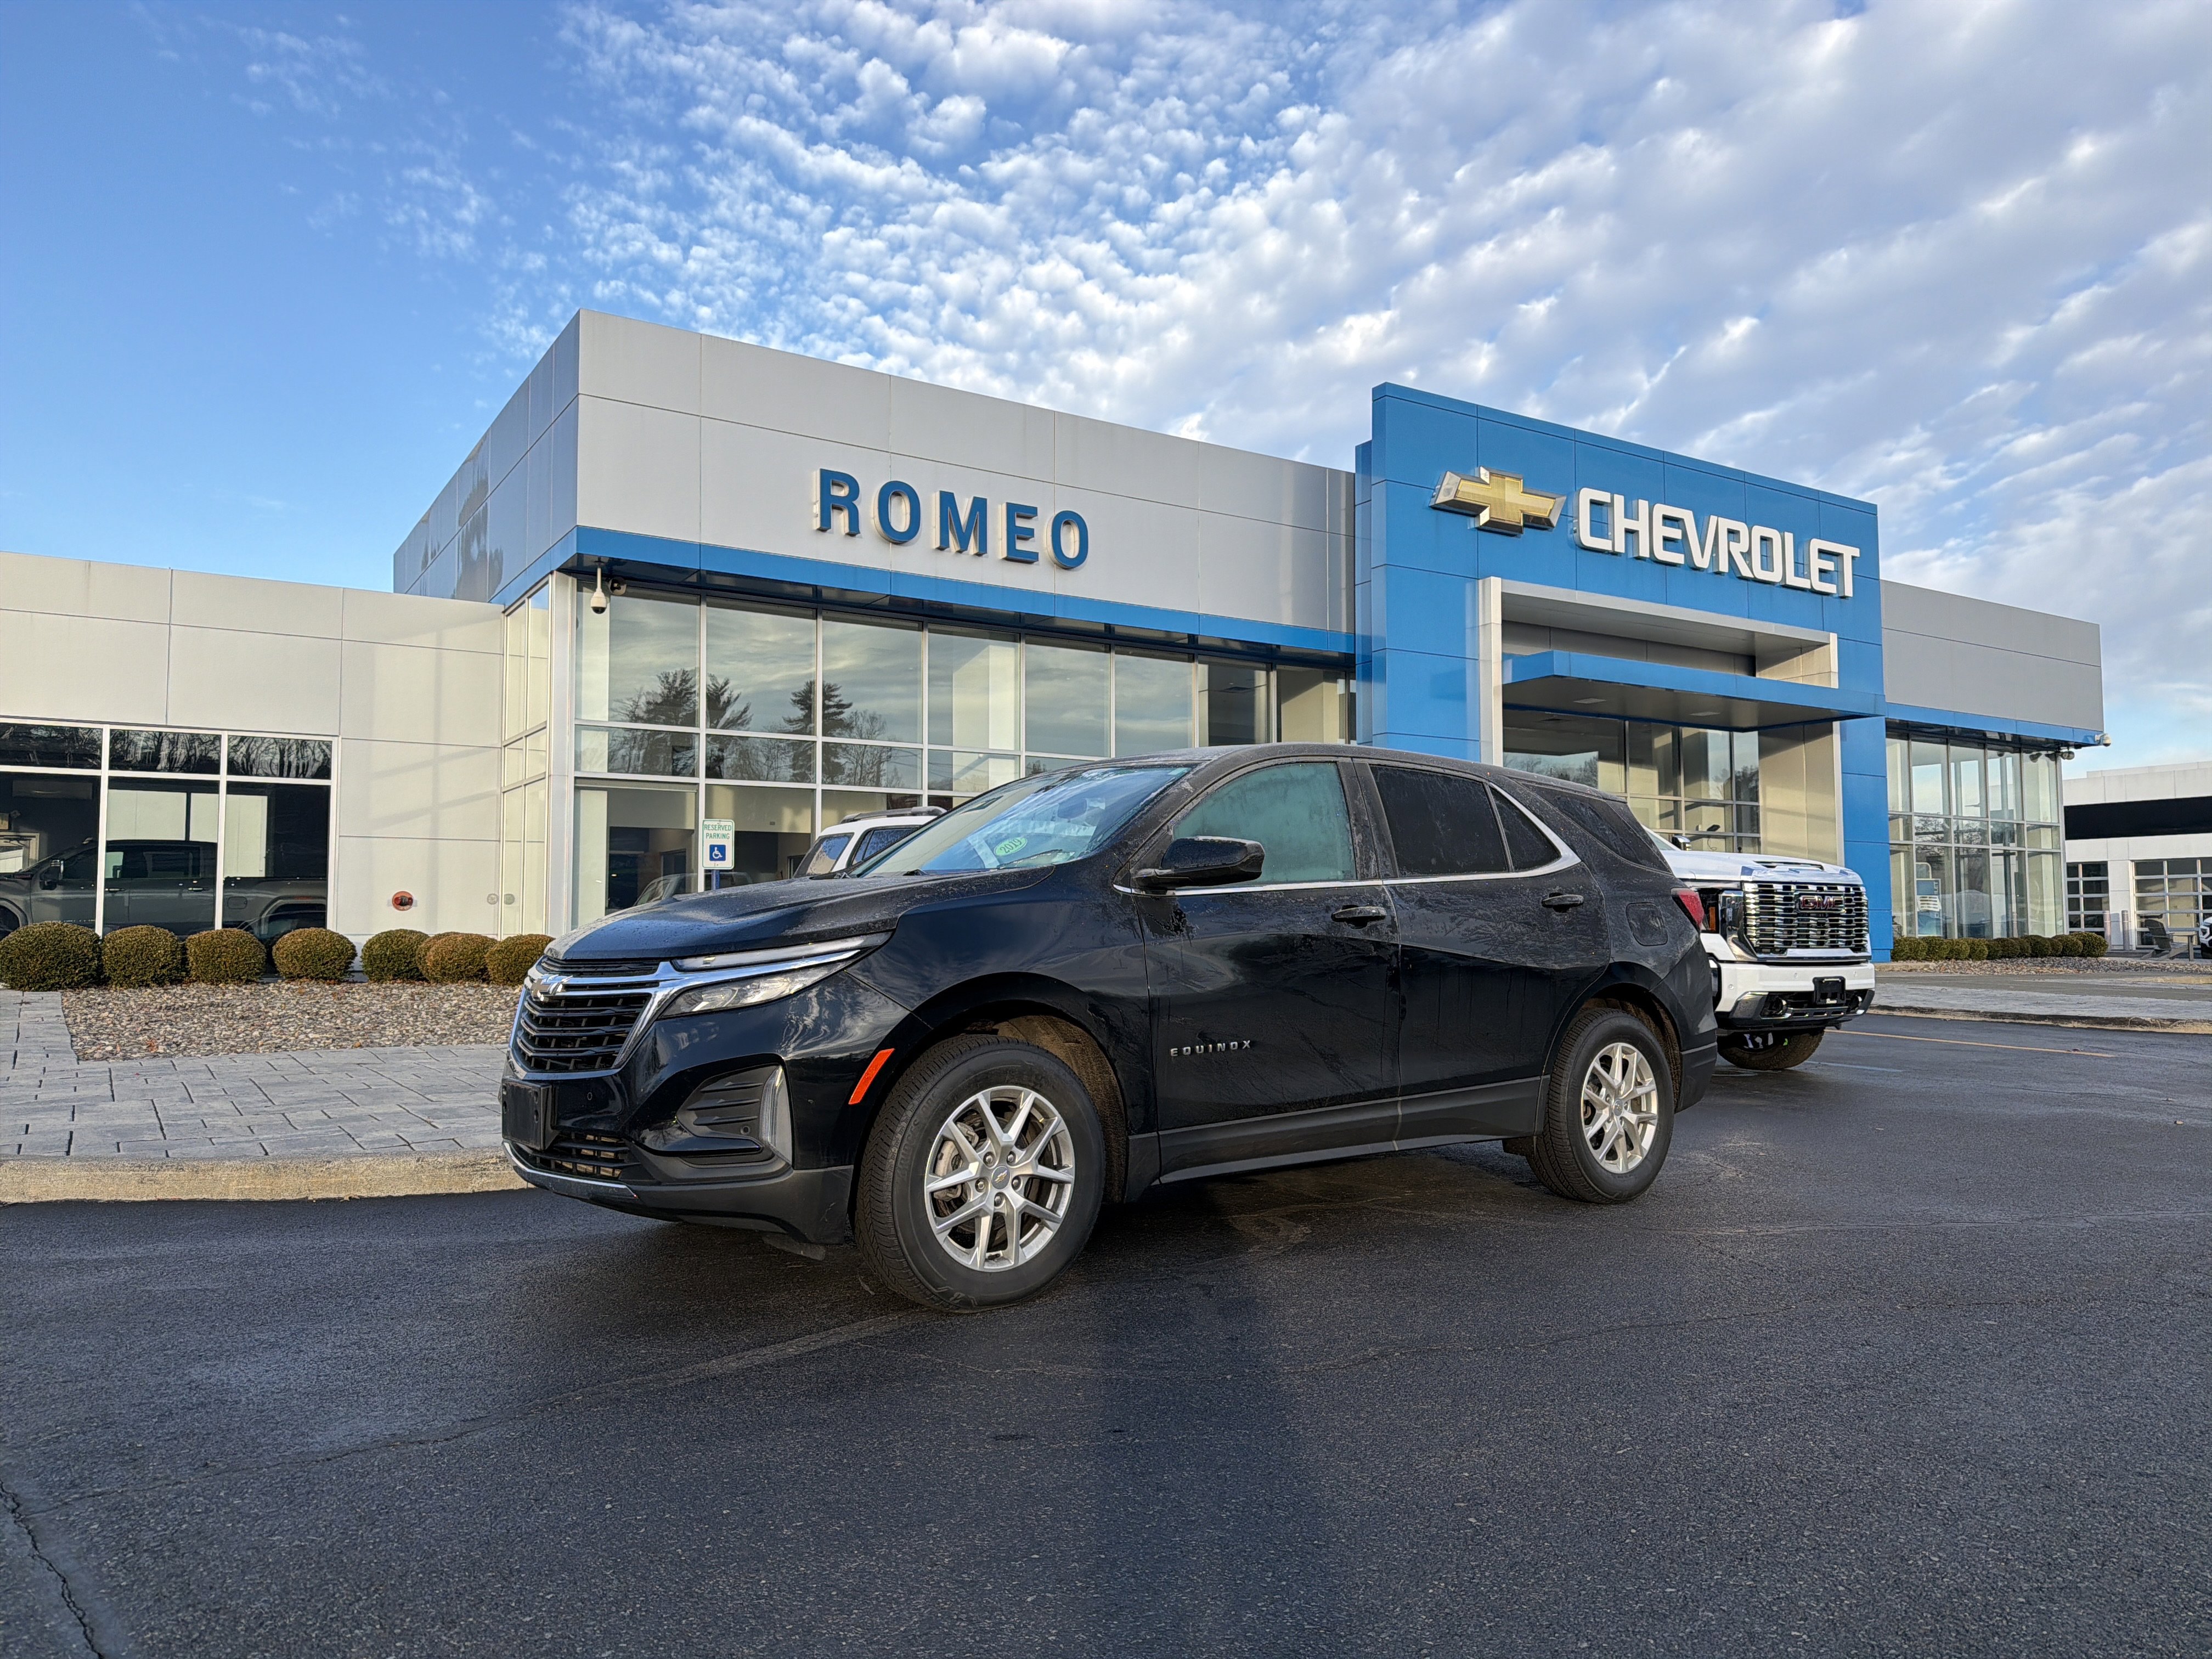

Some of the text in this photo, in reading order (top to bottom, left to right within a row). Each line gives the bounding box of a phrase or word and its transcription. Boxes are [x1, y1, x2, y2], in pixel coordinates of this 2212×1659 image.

[814, 468, 1088, 569] ROMEO
[1576, 487, 1860, 597] CHEVROLET
[1000, 838, 1022, 854] 2019
[1801, 895, 1844, 910] GMC
[1170, 1040, 1251, 1057] EQUINOX
